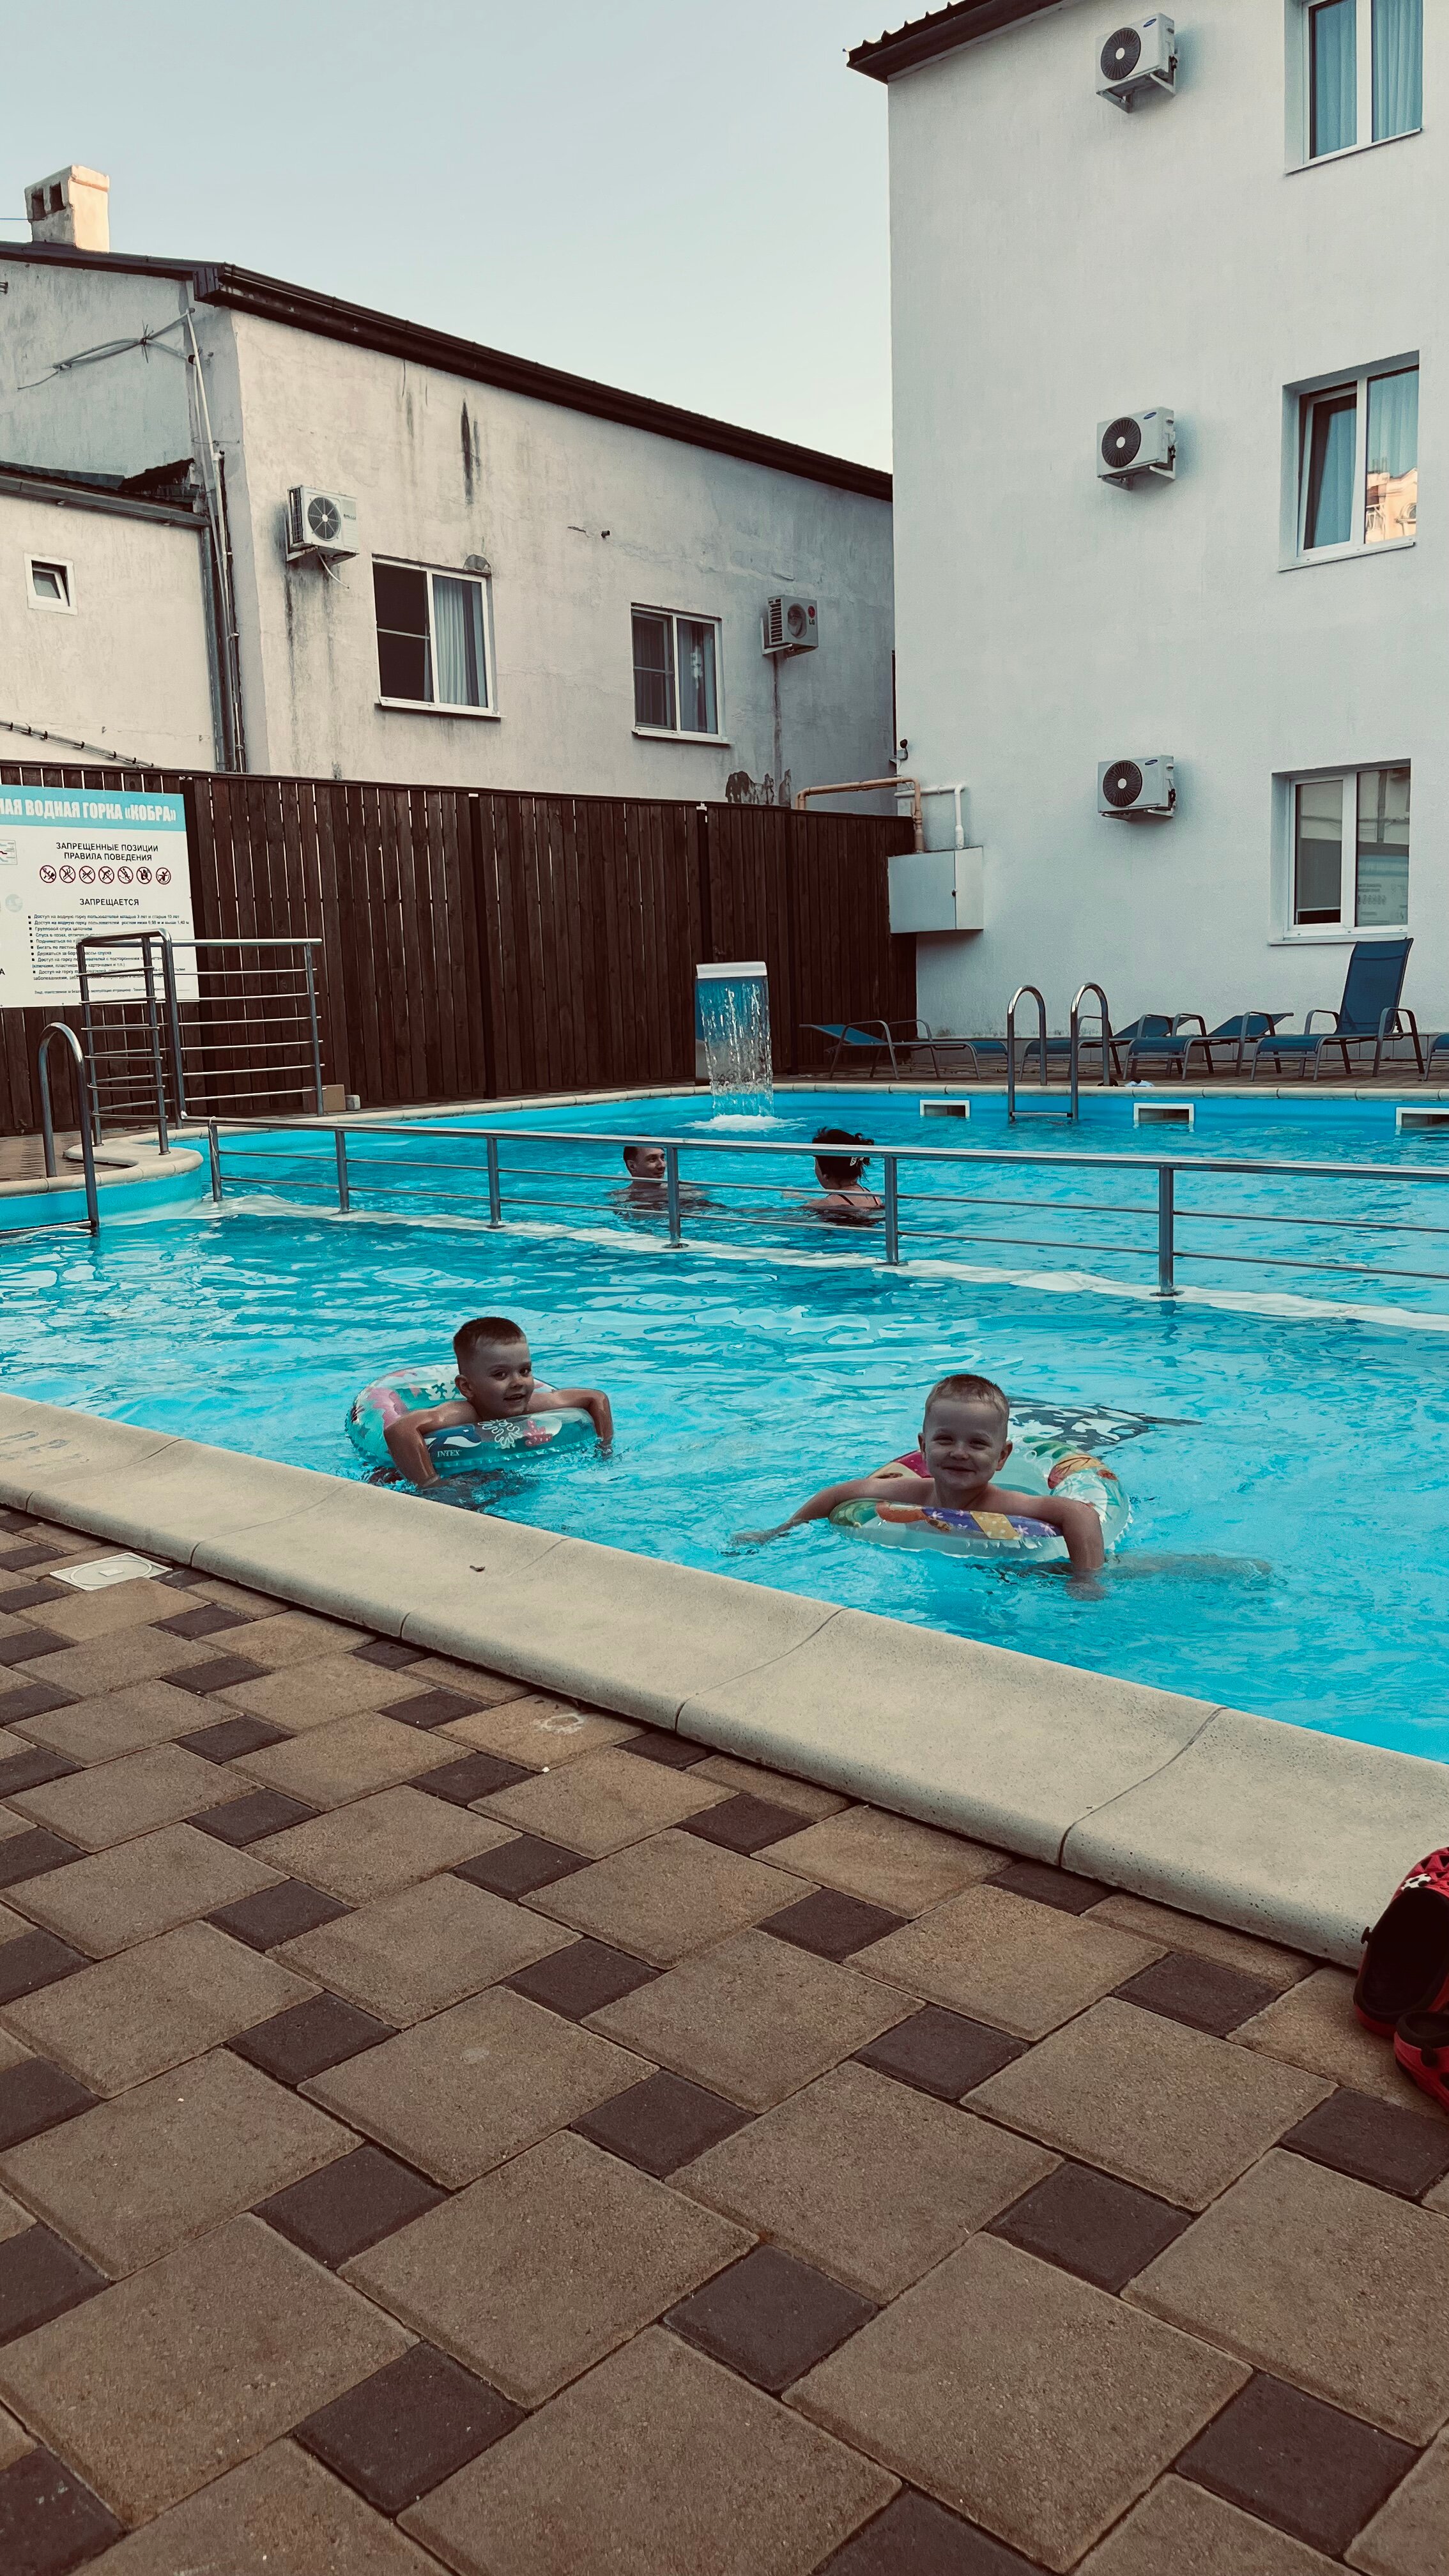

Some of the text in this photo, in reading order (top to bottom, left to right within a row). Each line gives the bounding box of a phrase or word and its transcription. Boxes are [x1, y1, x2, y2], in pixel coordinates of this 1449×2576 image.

[25, 799, 80, 820] ВОДНАЯ
[82, 802, 123, 820] ГОРКА
[125, 804, 176, 822] «КОБРА»
[56, 842, 158, 852] ЗАПРЕЩЕННЫЕ ПОЗИЦИИ
[104, 853, 152, 862] ПОВЕДЕНИЯ
[79, 898, 139, 907] ЗАПРЕЩАЕТСЯ
